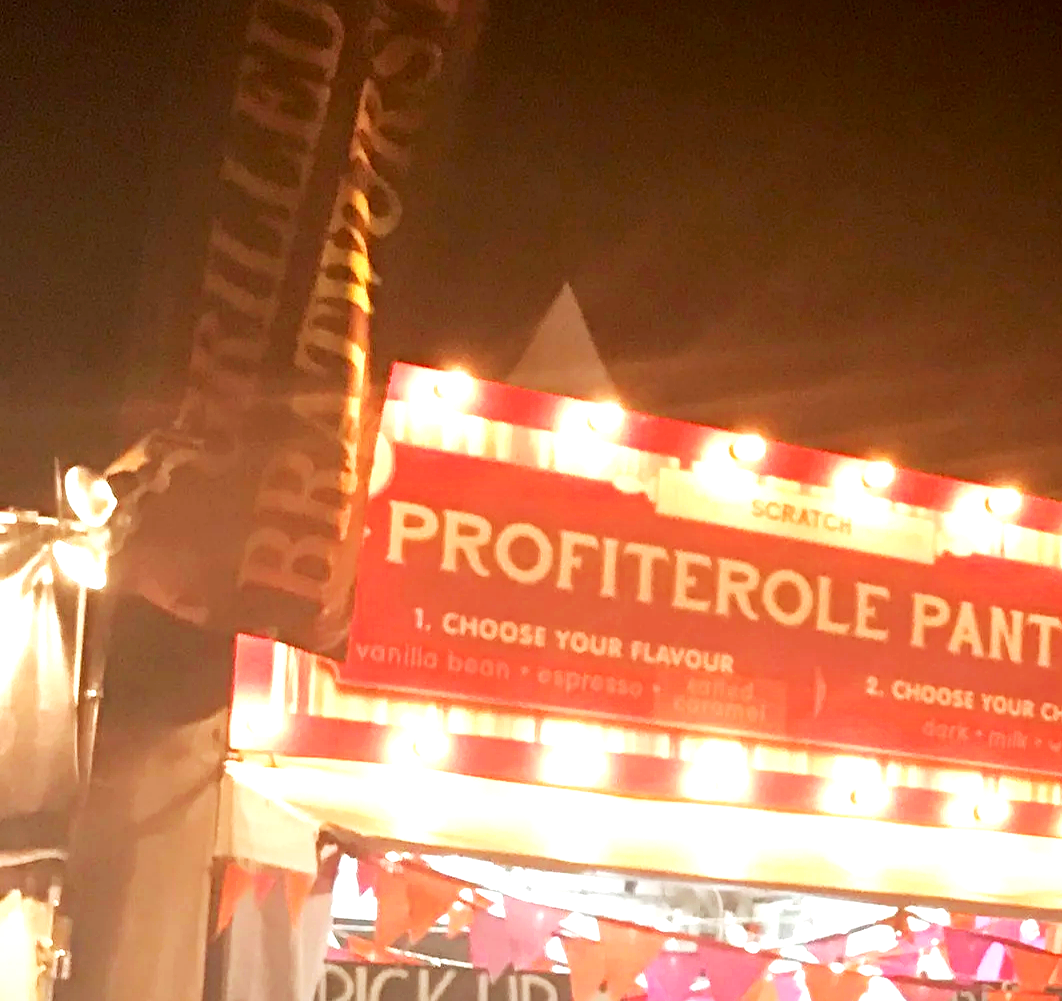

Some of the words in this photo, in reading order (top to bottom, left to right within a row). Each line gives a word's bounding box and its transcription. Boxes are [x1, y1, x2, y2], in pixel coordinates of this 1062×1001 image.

[751, 499, 851, 535] SCRATCH
[385, 499, 890, 642] PROFITEROLE
[414, 607, 431, 632] 1.
[442, 612, 547, 648] CHOOSE
[555, 629, 623, 659] YOUR
[630, 640, 735, 673] FLAVOUR
[355, 641, 438, 670] vanilla
[447, 650, 510, 681] bean
[537, 667, 644, 699] espresso
[865, 677, 884, 698] 2.
[891, 680, 974, 710] CHOOSE
[981, 692, 1035, 718] YOUR
[921, 718, 970, 741] dark
[988, 729, 1028, 750] milk
